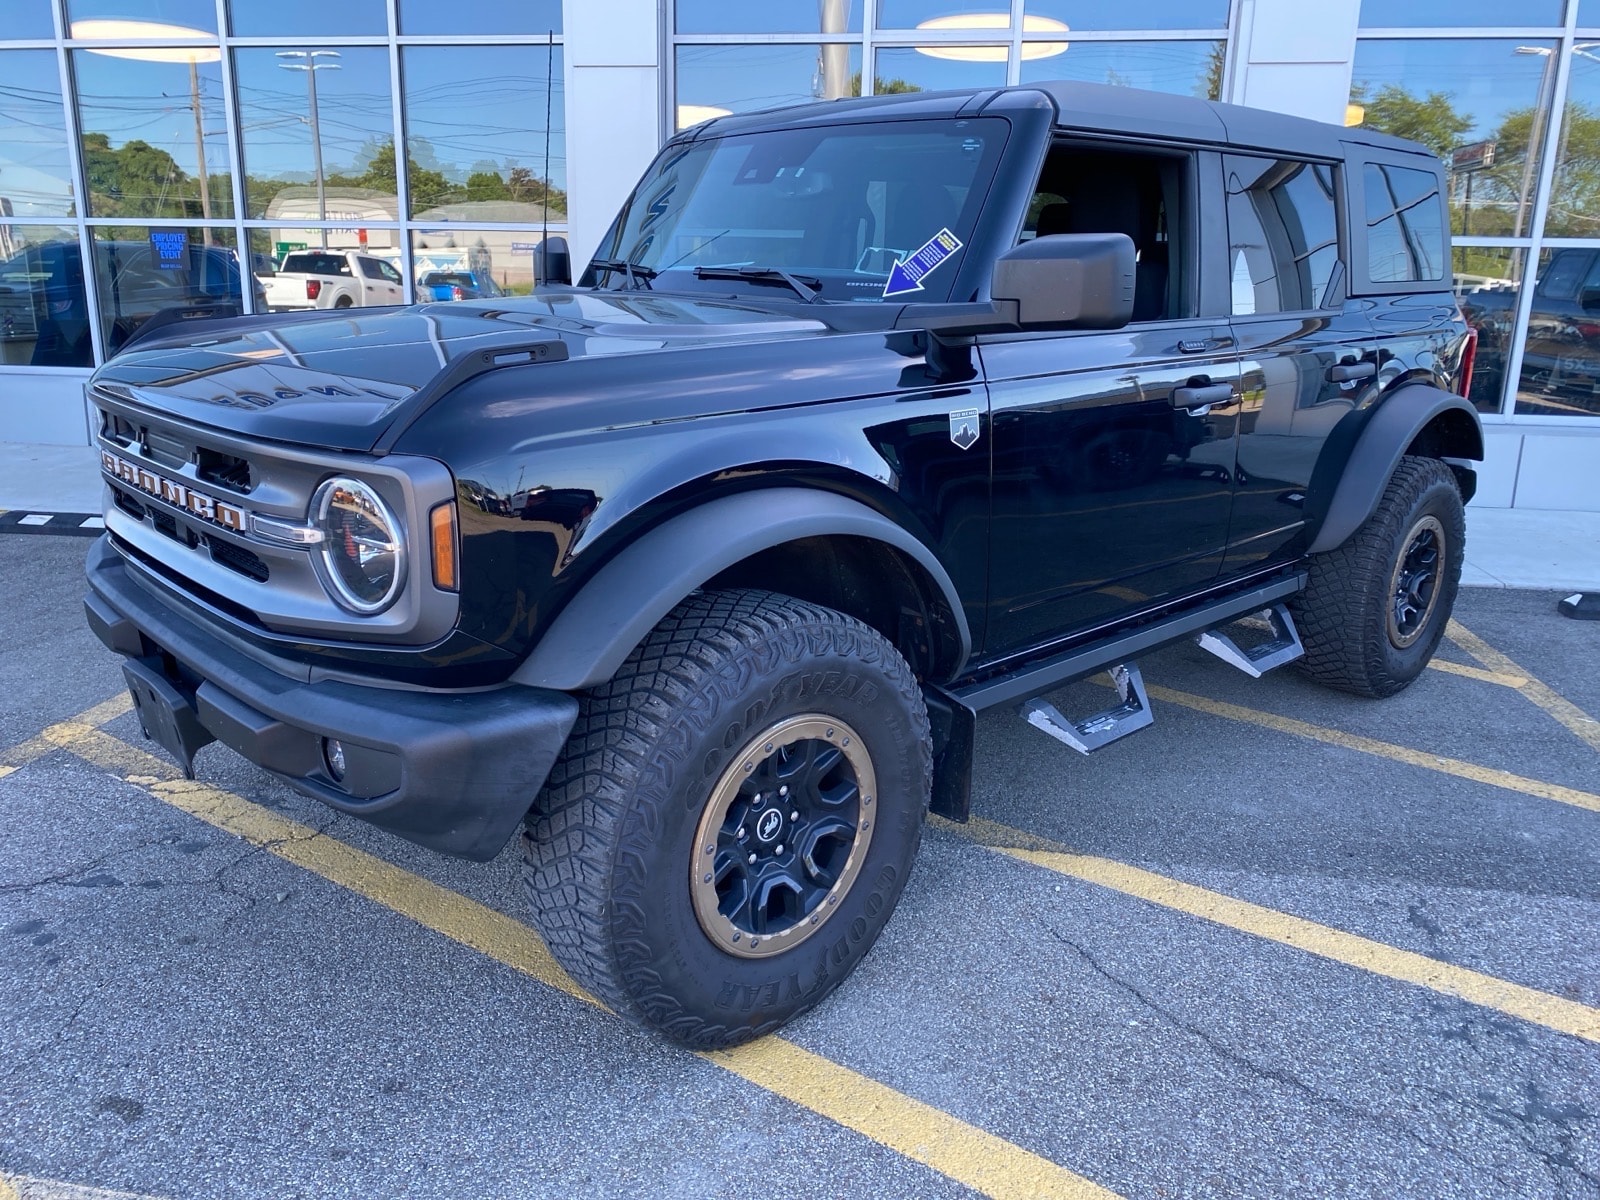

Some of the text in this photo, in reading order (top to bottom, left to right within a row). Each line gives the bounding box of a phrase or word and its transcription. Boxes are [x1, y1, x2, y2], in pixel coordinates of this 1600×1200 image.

[151, 233, 186, 242] EMPLOYEE
[156, 242, 184, 250] PRICING
[160, 250, 181, 259] EVENT
[101, 449, 247, 531] BRONCO
